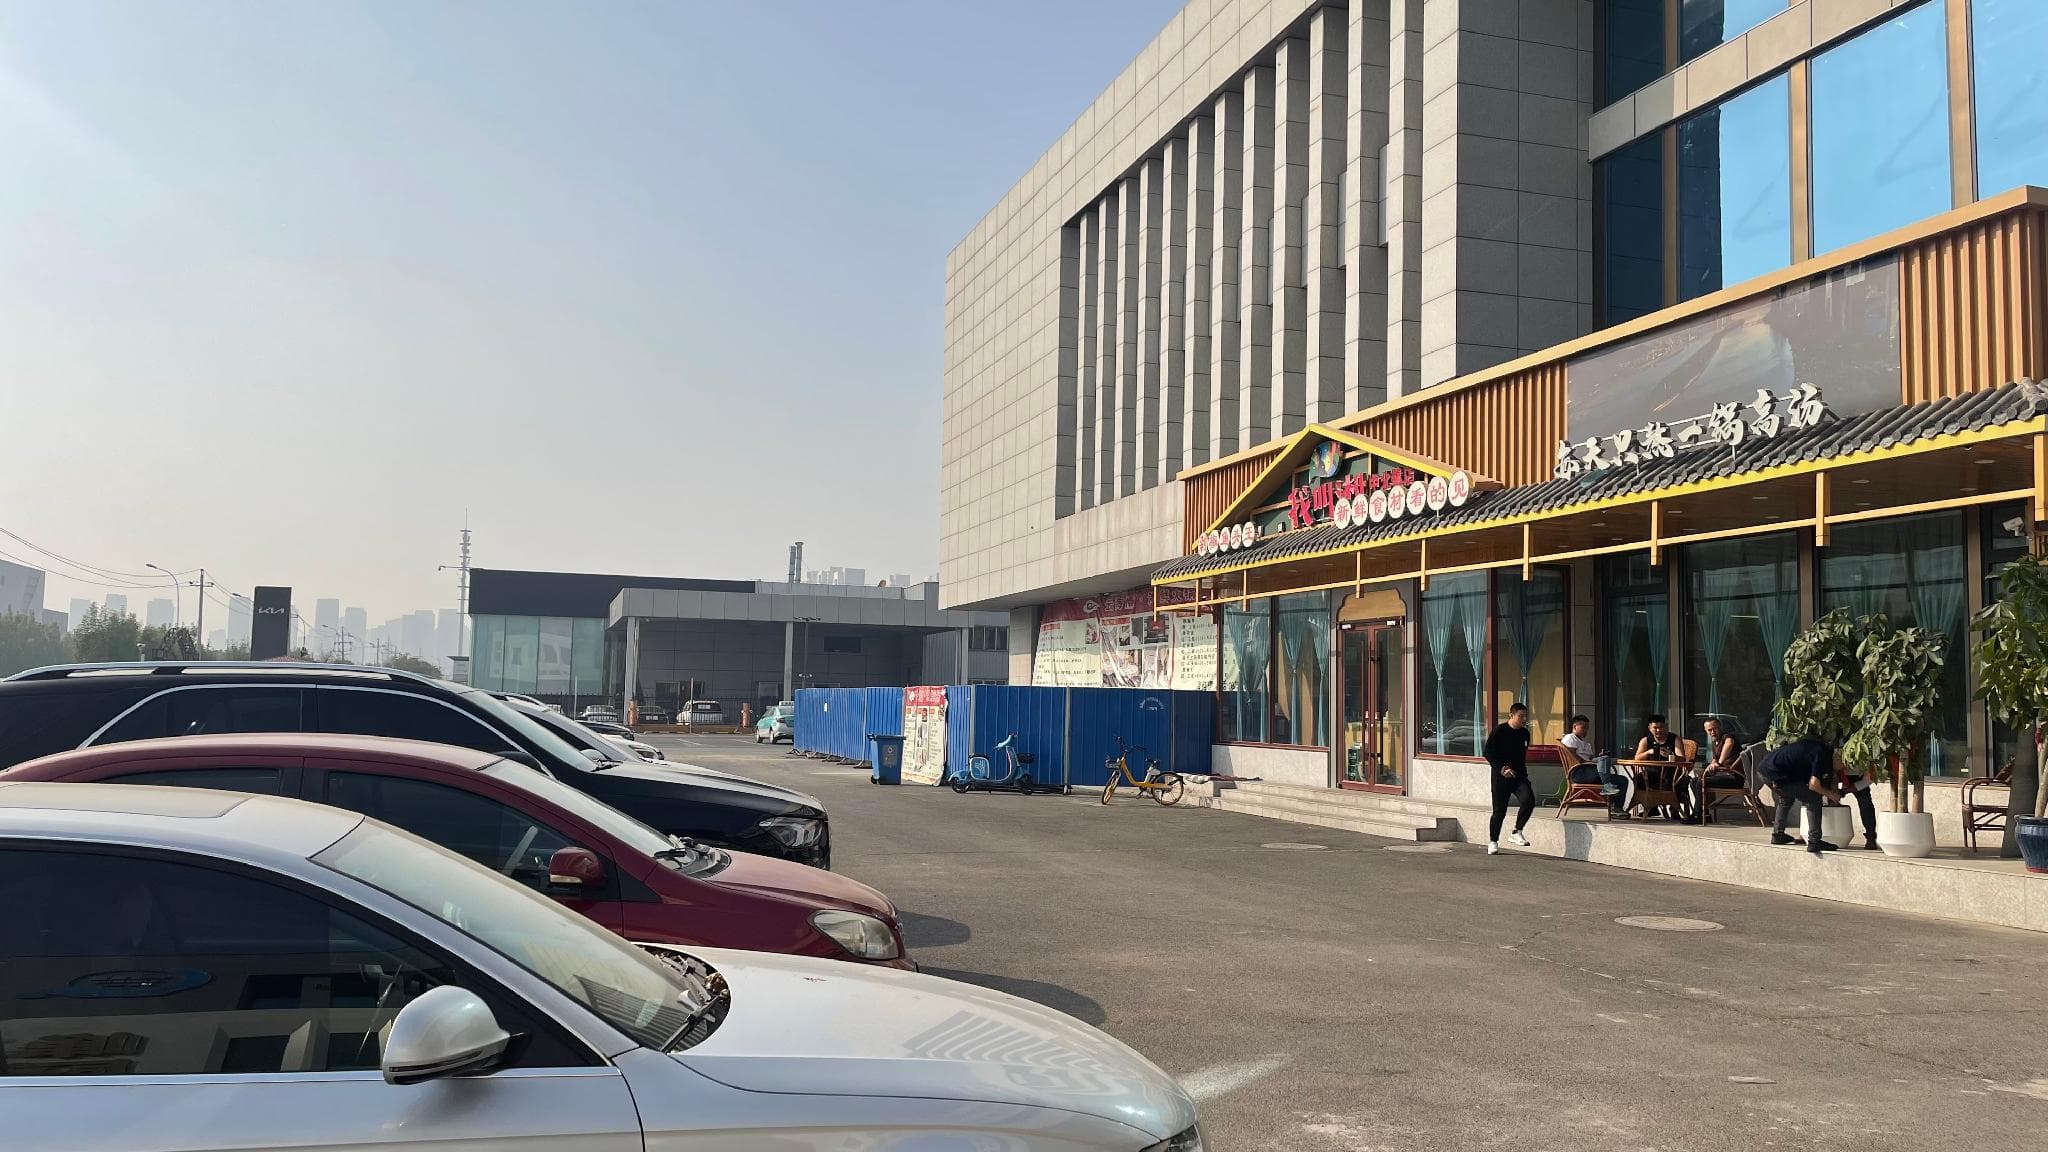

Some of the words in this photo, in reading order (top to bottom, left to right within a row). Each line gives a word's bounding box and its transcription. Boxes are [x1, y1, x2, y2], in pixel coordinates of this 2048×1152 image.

[1335, 474, 1469, 526] 新鲜食材看的见
